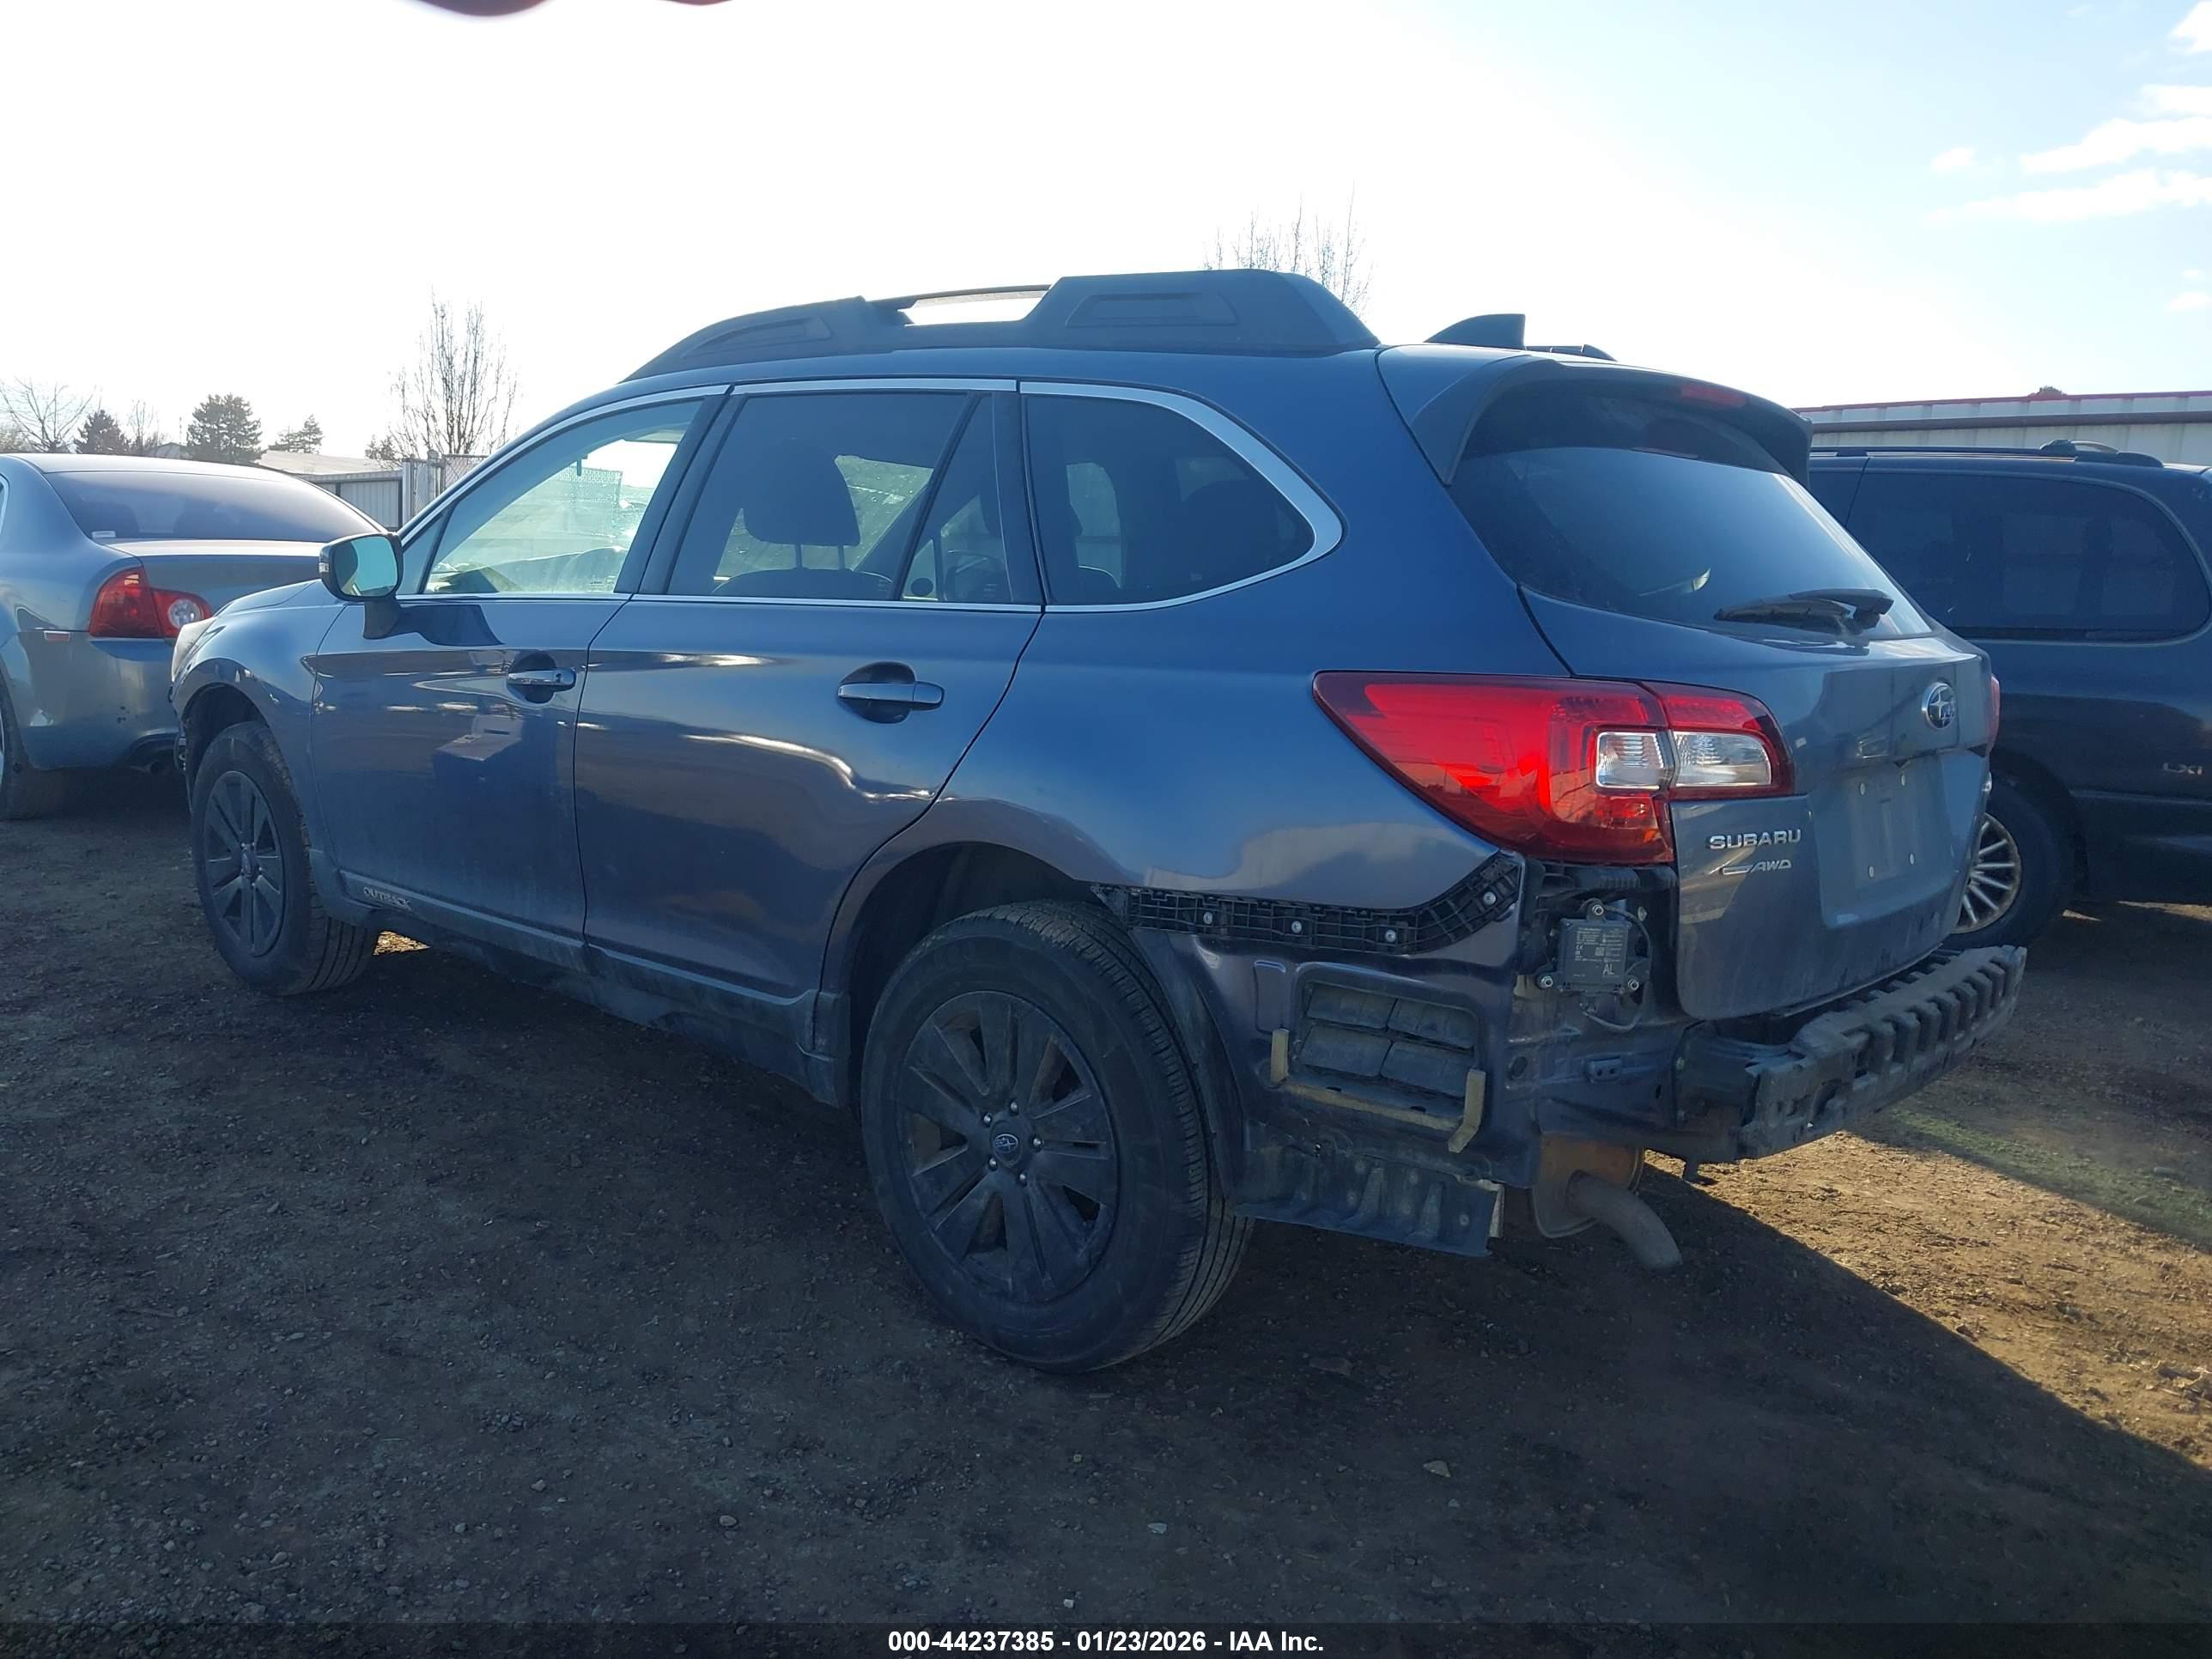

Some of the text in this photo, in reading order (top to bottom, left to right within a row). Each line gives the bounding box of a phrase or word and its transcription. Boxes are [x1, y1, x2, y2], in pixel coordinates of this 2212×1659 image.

[1709, 829, 1802, 850] SUBARU
[1750, 859, 1792, 873] AWD
[1602, 963, 1615, 975] AL
